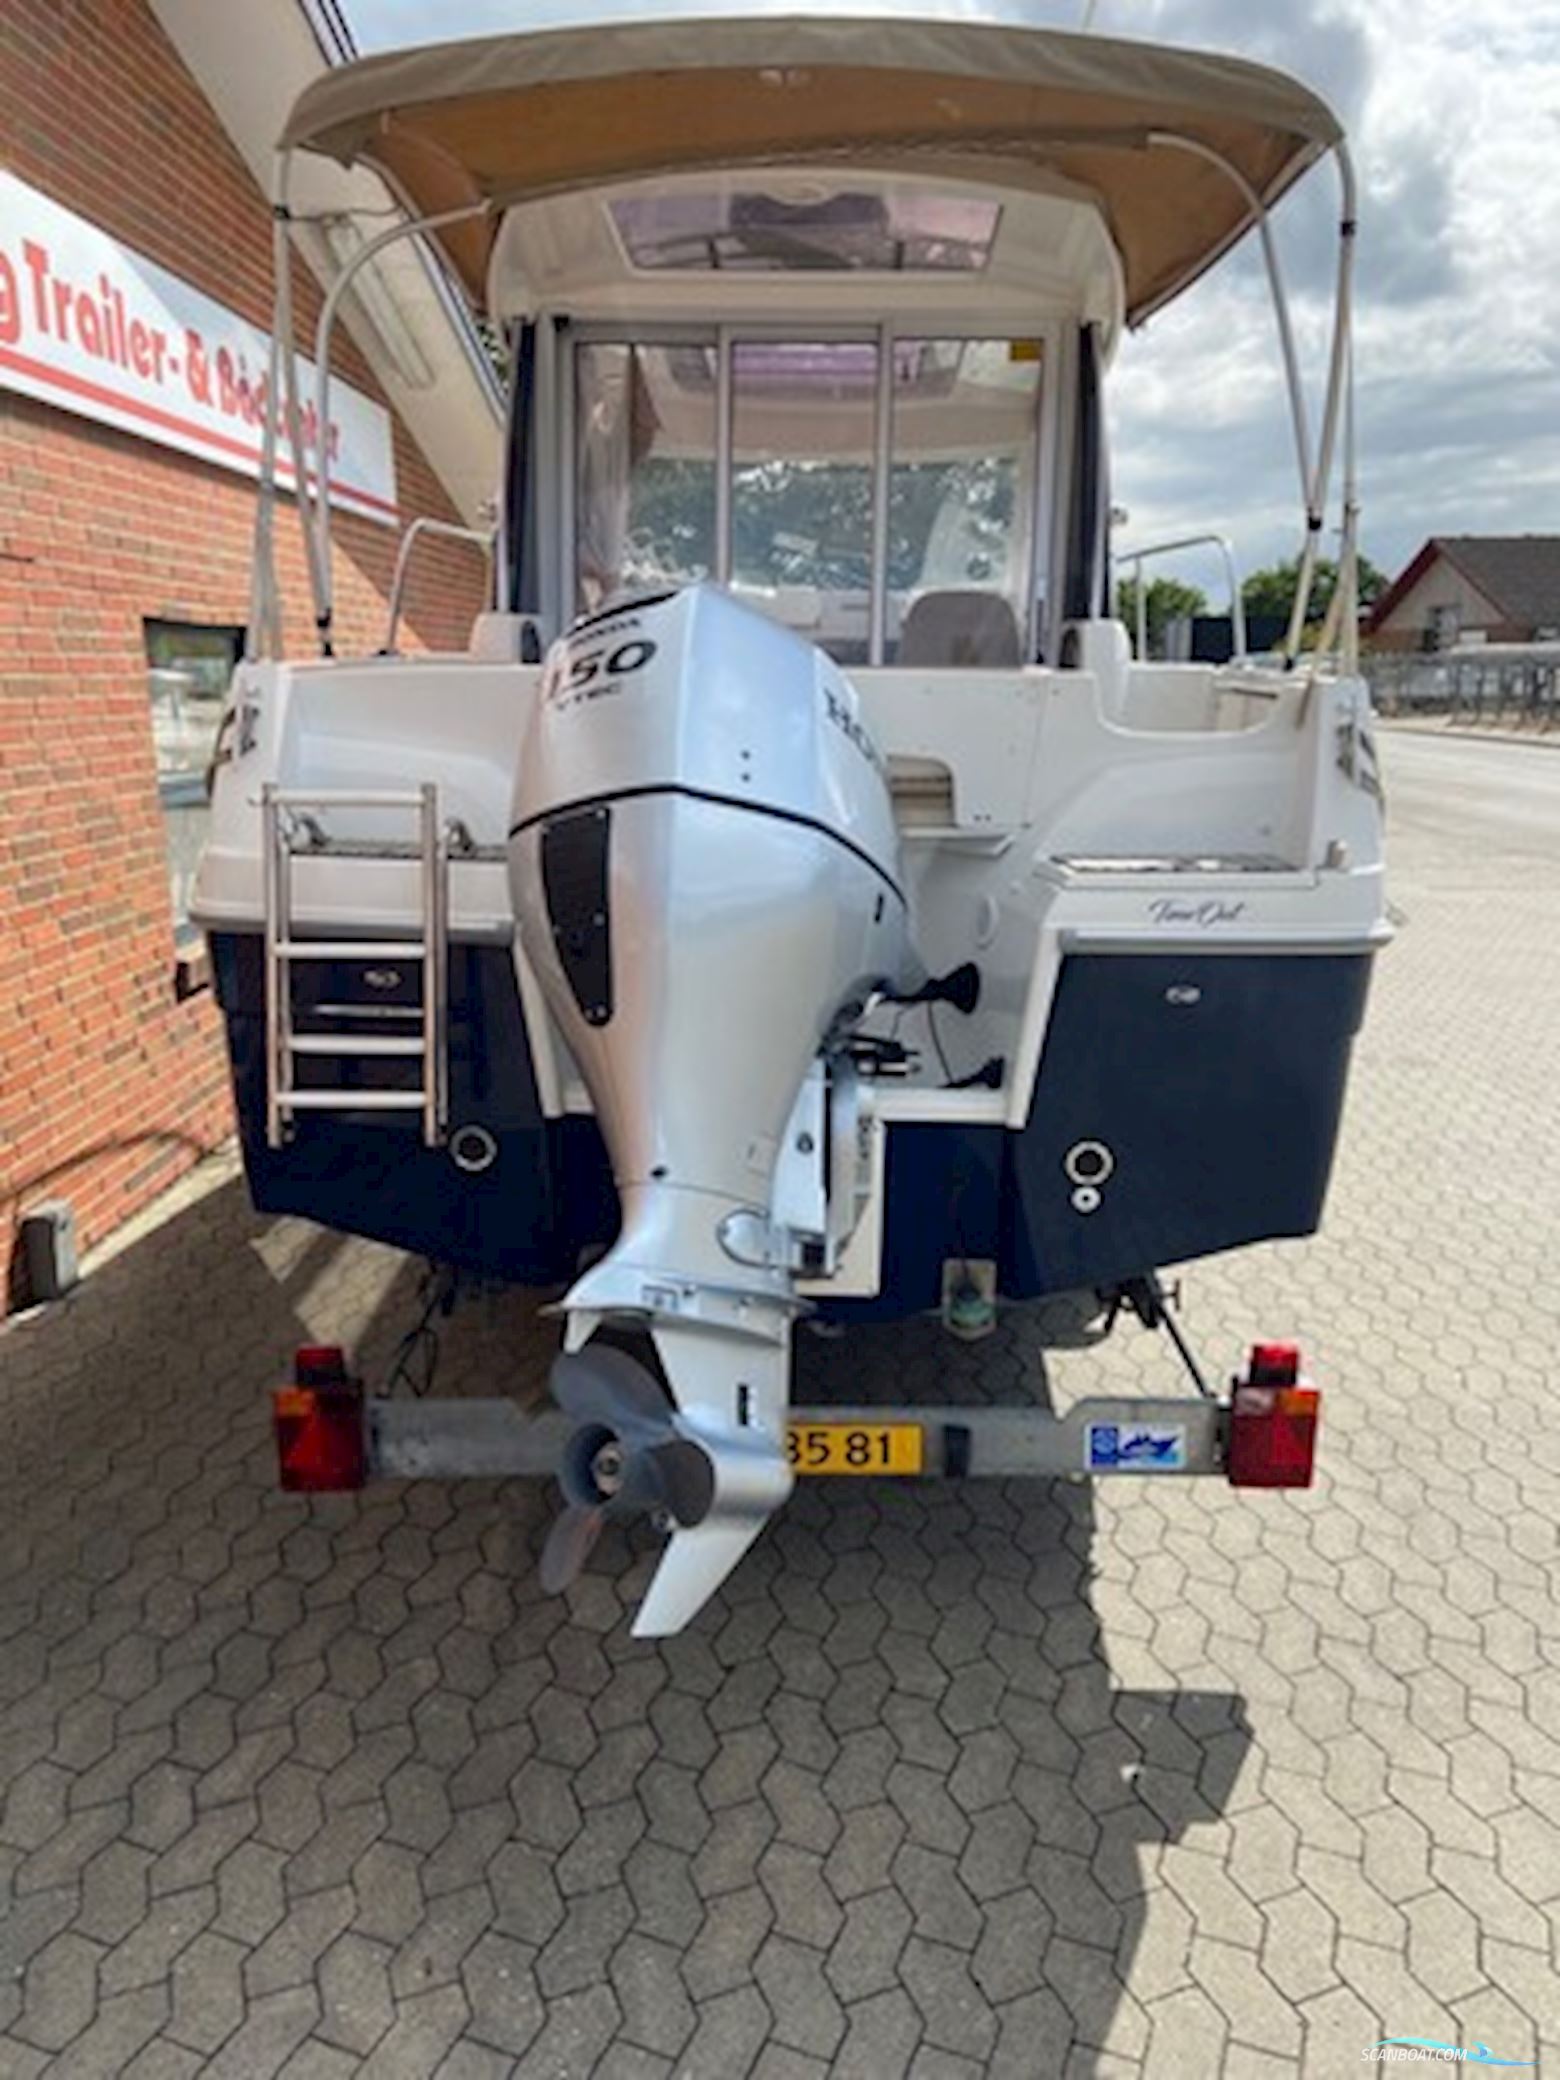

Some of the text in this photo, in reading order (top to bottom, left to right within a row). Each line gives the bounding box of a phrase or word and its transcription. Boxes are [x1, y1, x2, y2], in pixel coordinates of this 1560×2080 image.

[22, 238, 179, 386] Trailer-
[186, 327, 214, 406] &
[847, 1431, 890, 1465] 81
